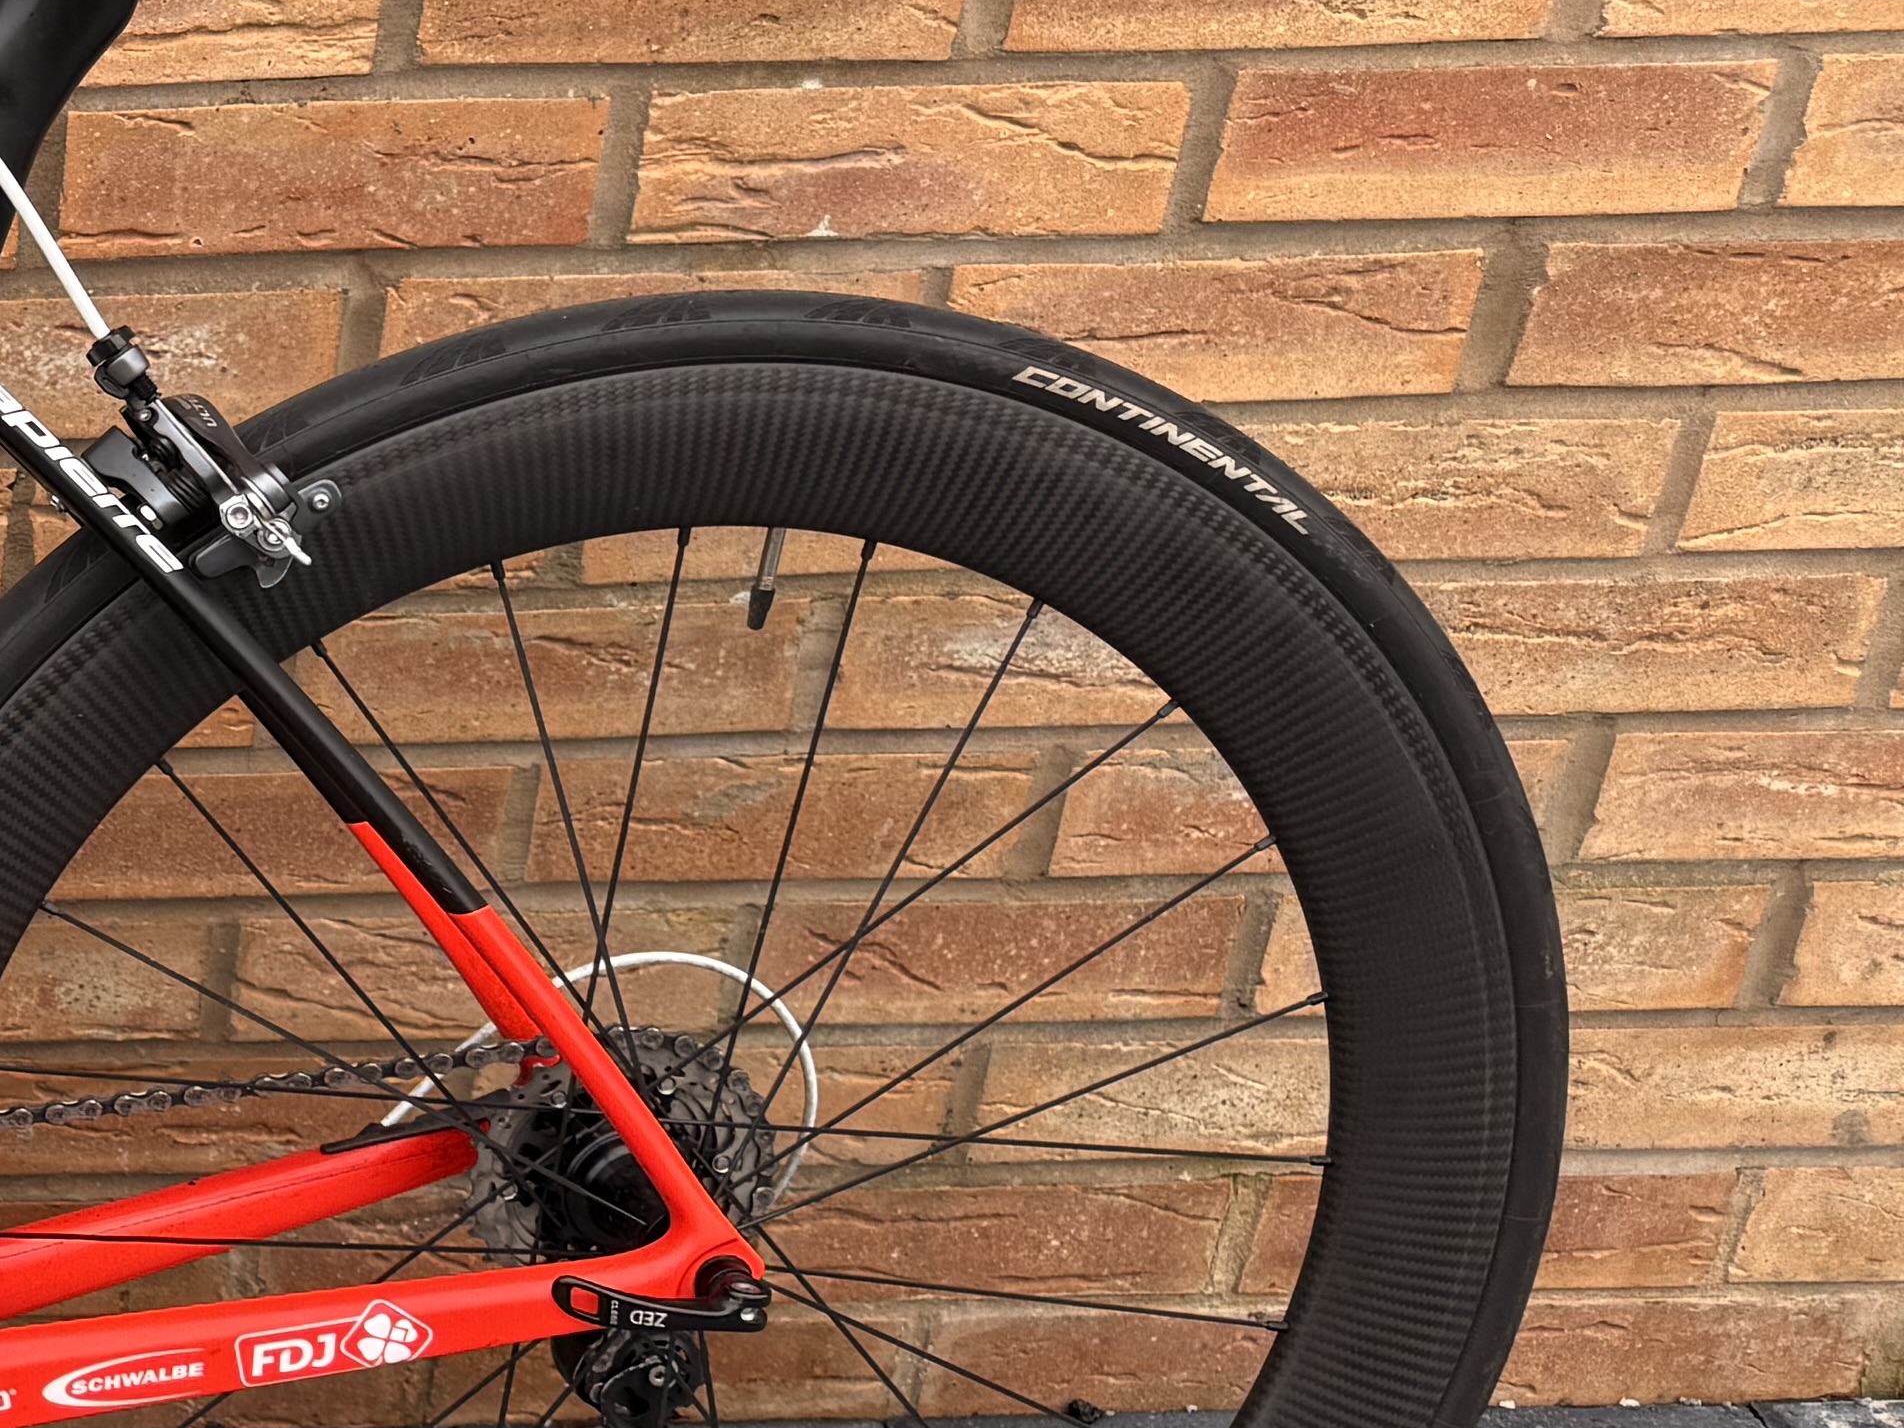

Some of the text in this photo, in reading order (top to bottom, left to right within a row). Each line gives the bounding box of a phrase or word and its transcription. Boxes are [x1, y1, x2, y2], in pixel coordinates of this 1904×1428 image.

[1011, 366, 1309, 536] CONTINENTAL
[629, 1310, 668, 1328] ZED
[250, 1333, 337, 1377] FDJ
[71, 1360, 205, 1395] SCHWALBE
